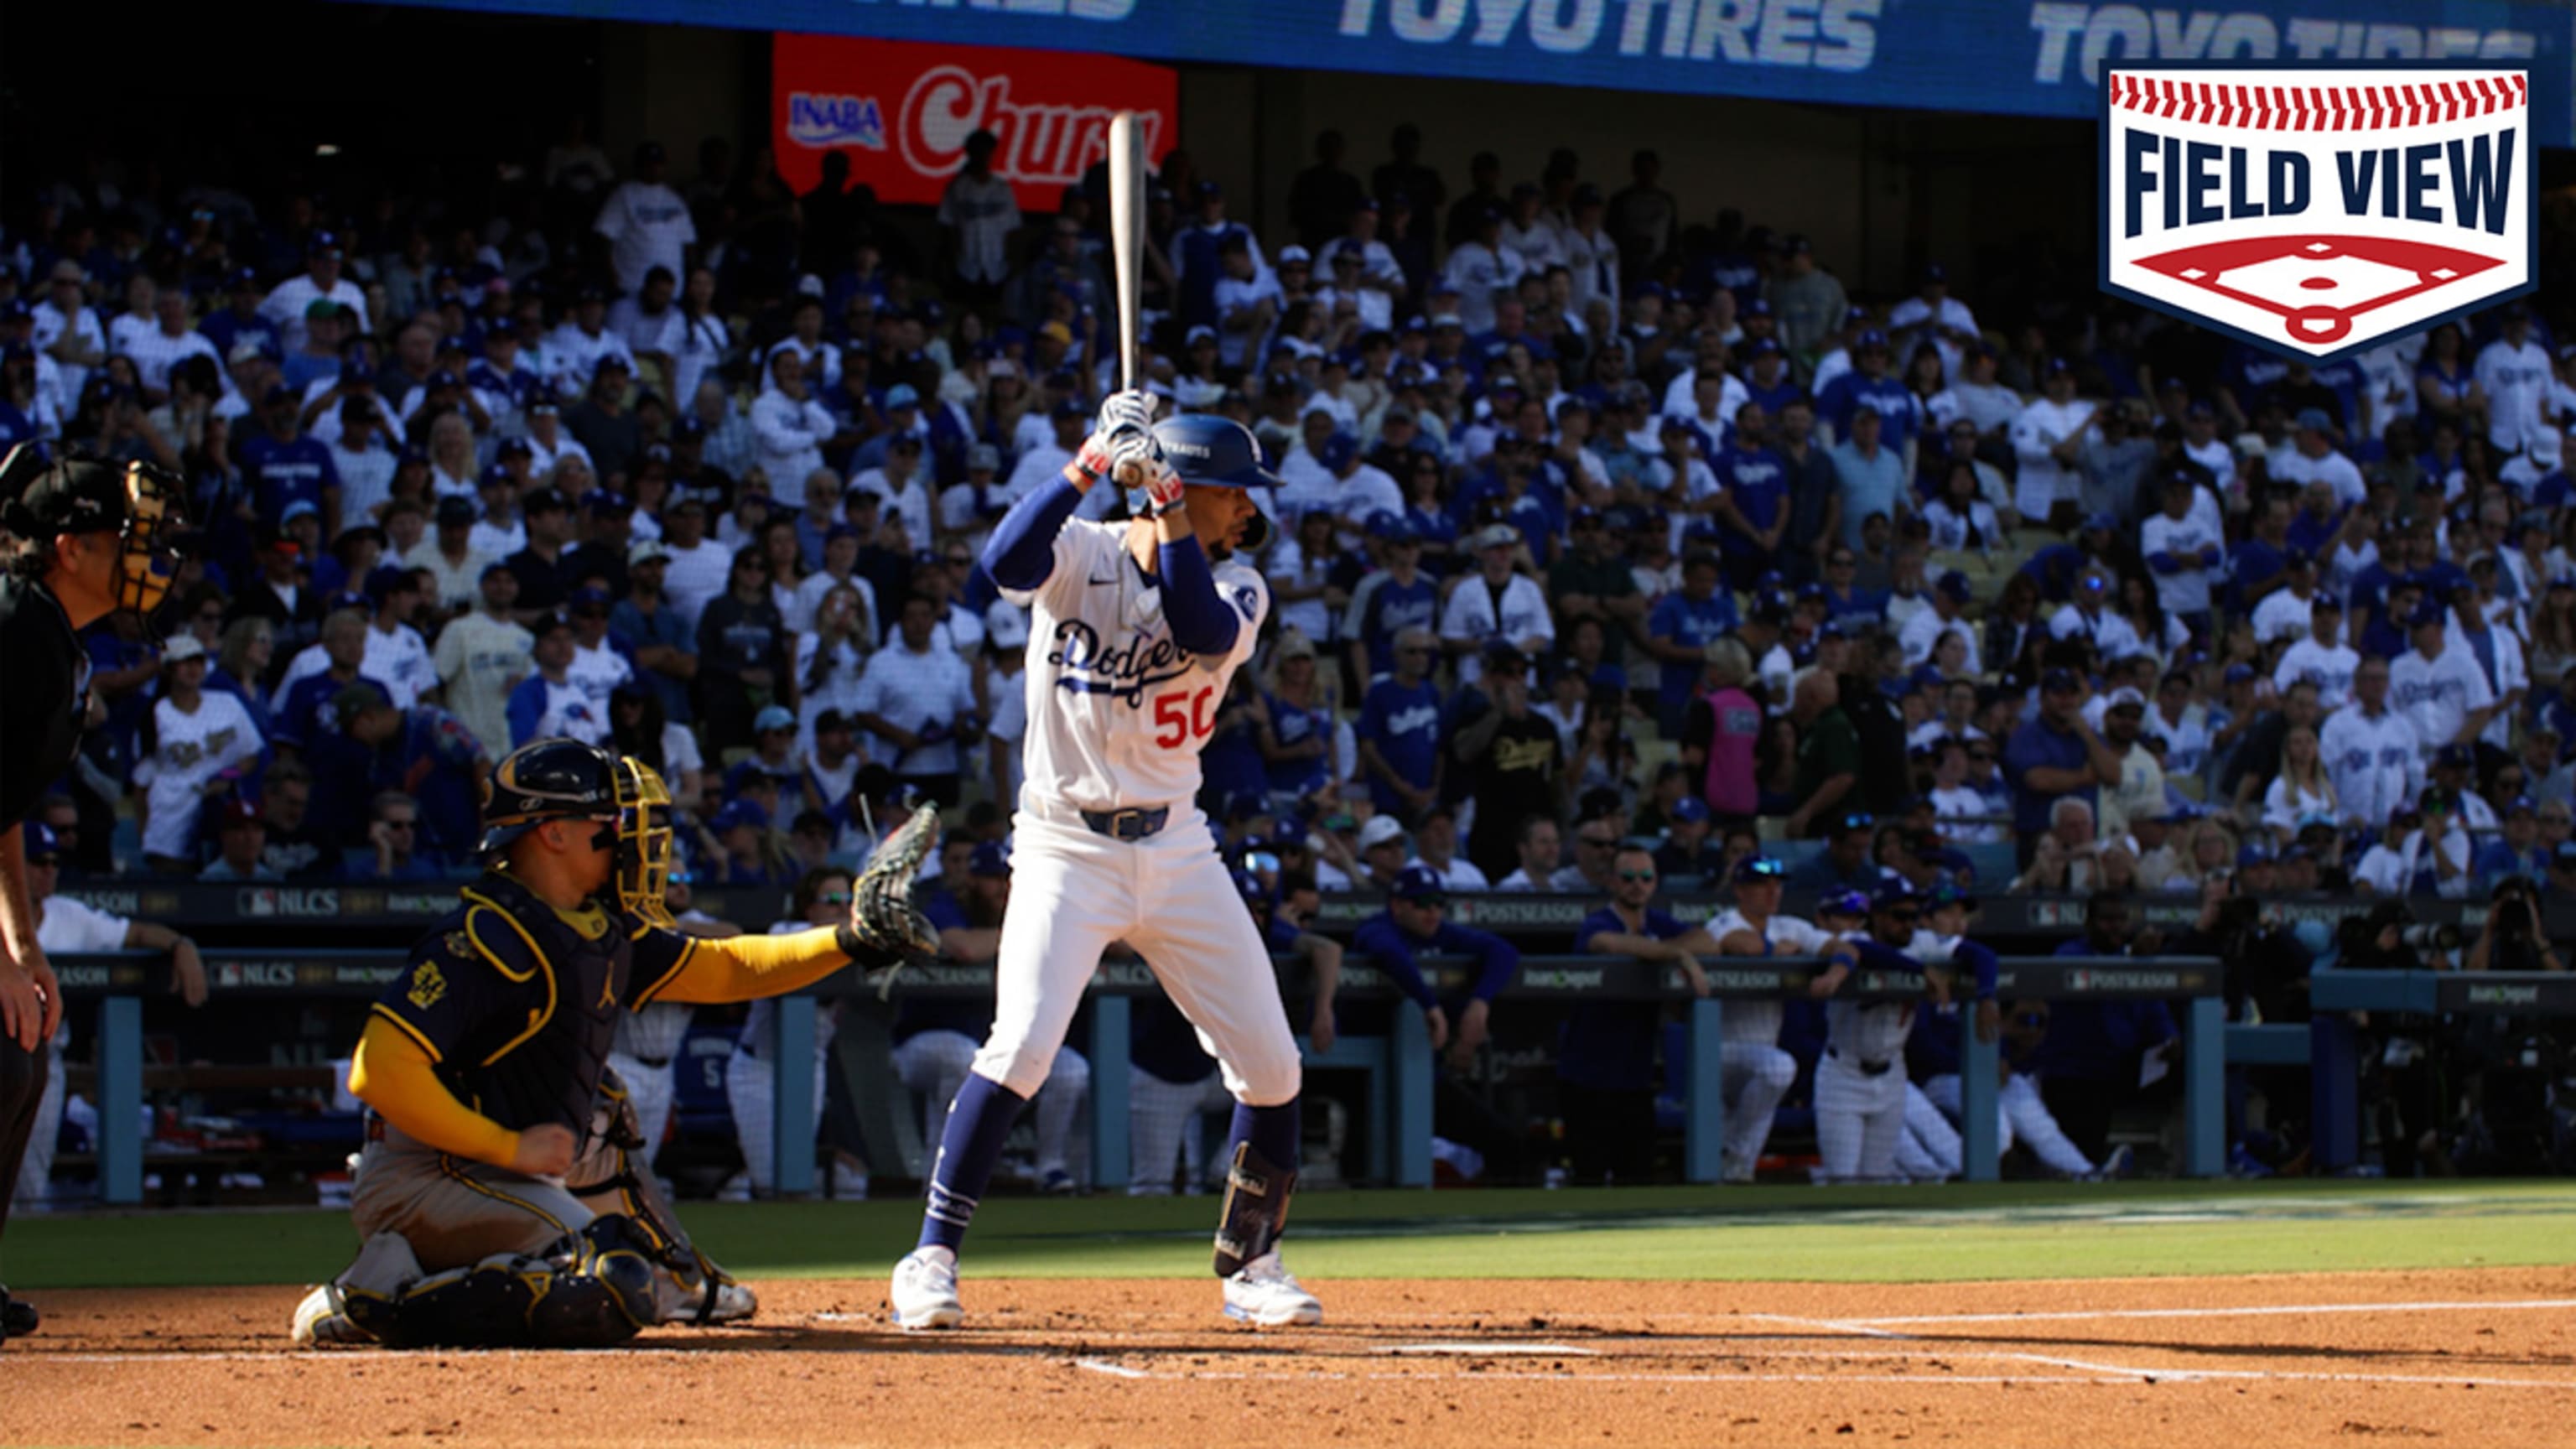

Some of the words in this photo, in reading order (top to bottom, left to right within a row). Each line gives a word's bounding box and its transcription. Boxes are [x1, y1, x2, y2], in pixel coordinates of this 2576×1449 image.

[791, 93, 881, 132] INABA
[896, 63, 1163, 184] Chur
[1047, 619, 1194, 709] Dodge
[1155, 686, 1216, 749] 50
[278, 887, 339, 916] NLCS
[1474, 901, 1585, 923] POSTSEASON
[242, 963, 295, 987] NLCS
